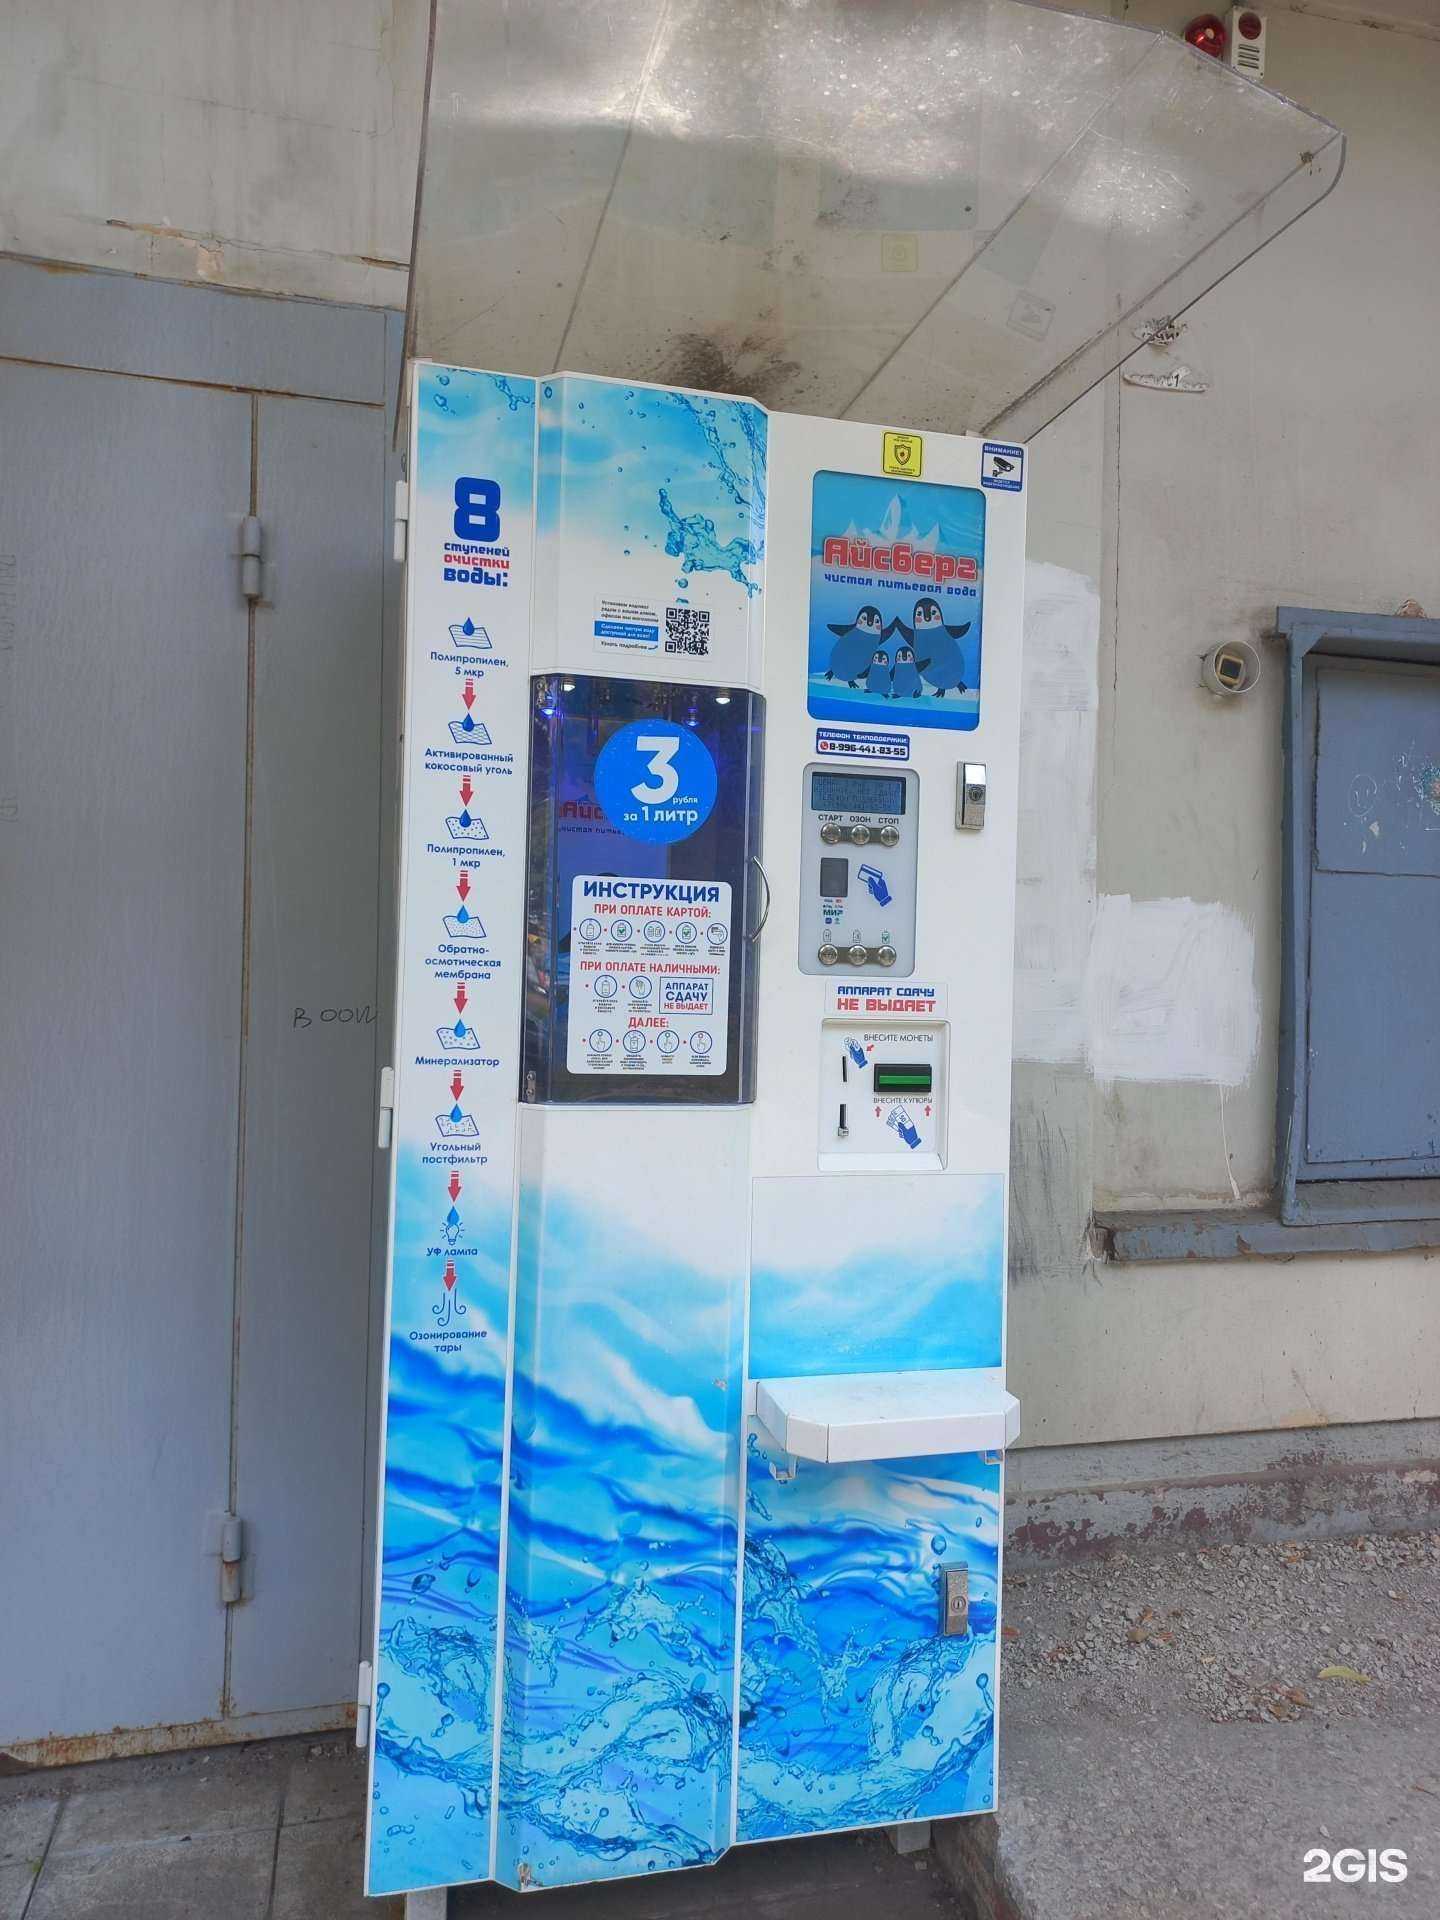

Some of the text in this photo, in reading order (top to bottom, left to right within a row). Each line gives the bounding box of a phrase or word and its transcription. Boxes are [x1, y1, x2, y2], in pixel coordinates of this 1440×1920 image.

[454, 476, 501, 542] 8
[444, 542, 510, 557] ступеней
[444, 554, 510, 569] очистки
[823, 537, 978, 583] Айсберг
[444, 567, 508, 587] воды:
[824, 573, 977, 597] чистая питьевая вода
[430, 651, 510, 667] Полипропилен,
[455, 666, 485, 678] 5 мкр
[818, 731, 851, 740] ТЕЛЕФОН
[425, 747, 514, 762] Активированный
[829, 742, 906, 756] 8-996-441-83-55
[425, 761, 513, 775] кокосовый уголь
[631, 736, 680, 804] 3
[672, 796, 698, 805] рубля
[623, 806, 699, 826] за 1 литр
[818, 814, 900, 825] СТАРТ ОЗОН СТОП
[427, 843, 506, 858] Полипропилен,
[452, 858, 481, 869] 1 мкр
[583, 880, 720, 903] ИНСТРУКЦИЯ
[594, 903, 712, 918] ПРИ ОПЛАТЕ КАРТОЙ:
[823, 909, 844, 917] МИР
[438, 944, 490, 955] Обратно-
[425, 957, 501, 967] осмотическая
[580, 960, 721, 975] ПРИ ОПЛАТЕ НАЛИЧНЫМИ:
[434, 970, 491, 980] мембрана
[665, 982, 709, 991] АППАРАТ
[837, 985, 935, 997] АППАРАТ СДАЧУ
[665, 991, 708, 1002] СДАЧУ
[663, 1002, 709, 1011] НЕ ВЫДАЕТ
[837, 998, 937, 1012] НЕ ВЫДАЕТ
[628, 1017, 669, 1029] ДАЛЕЕ:
[863, 1034, 934, 1042] ВНЕСИТЕ МОНЕТЫ
[415, 1056, 500, 1068] Минерализатор
[430, 1142, 481, 1152] Угольный
[422, 1155, 488, 1166] постфильтр
[444, 1248, 478, 1256] лампа
[409, 1330, 488, 1341] Озонирование
[435, 1344, 462, 1353] тары
